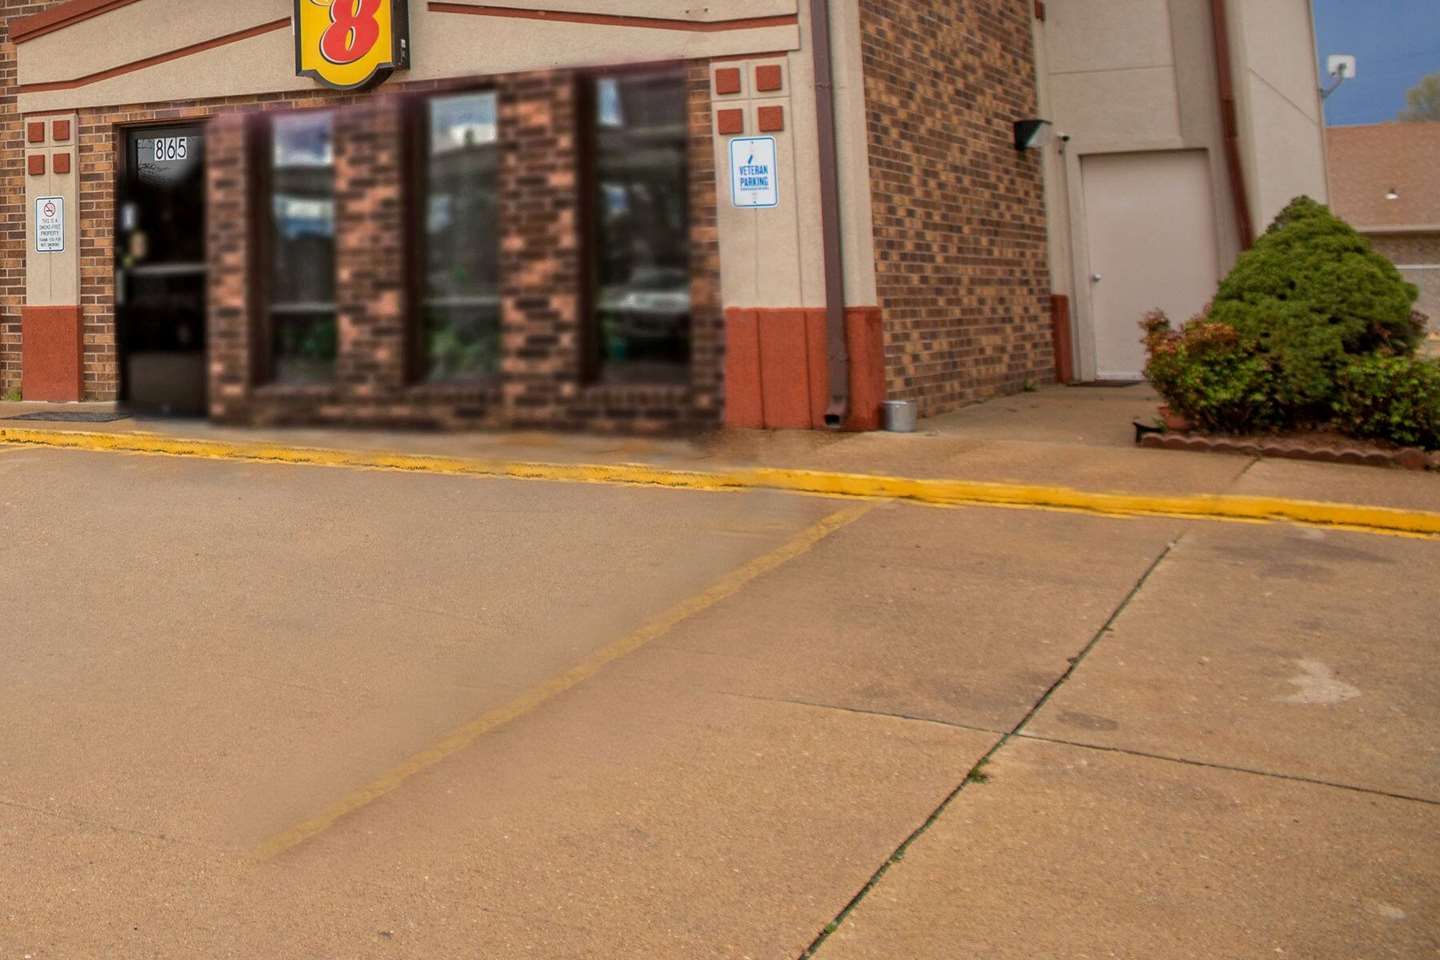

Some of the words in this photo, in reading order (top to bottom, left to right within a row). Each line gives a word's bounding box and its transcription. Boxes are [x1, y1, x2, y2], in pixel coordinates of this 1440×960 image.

[156, 138, 186, 159] 865
[740, 165, 768, 175] VETERAN
[740, 177, 768, 187] PARKING
